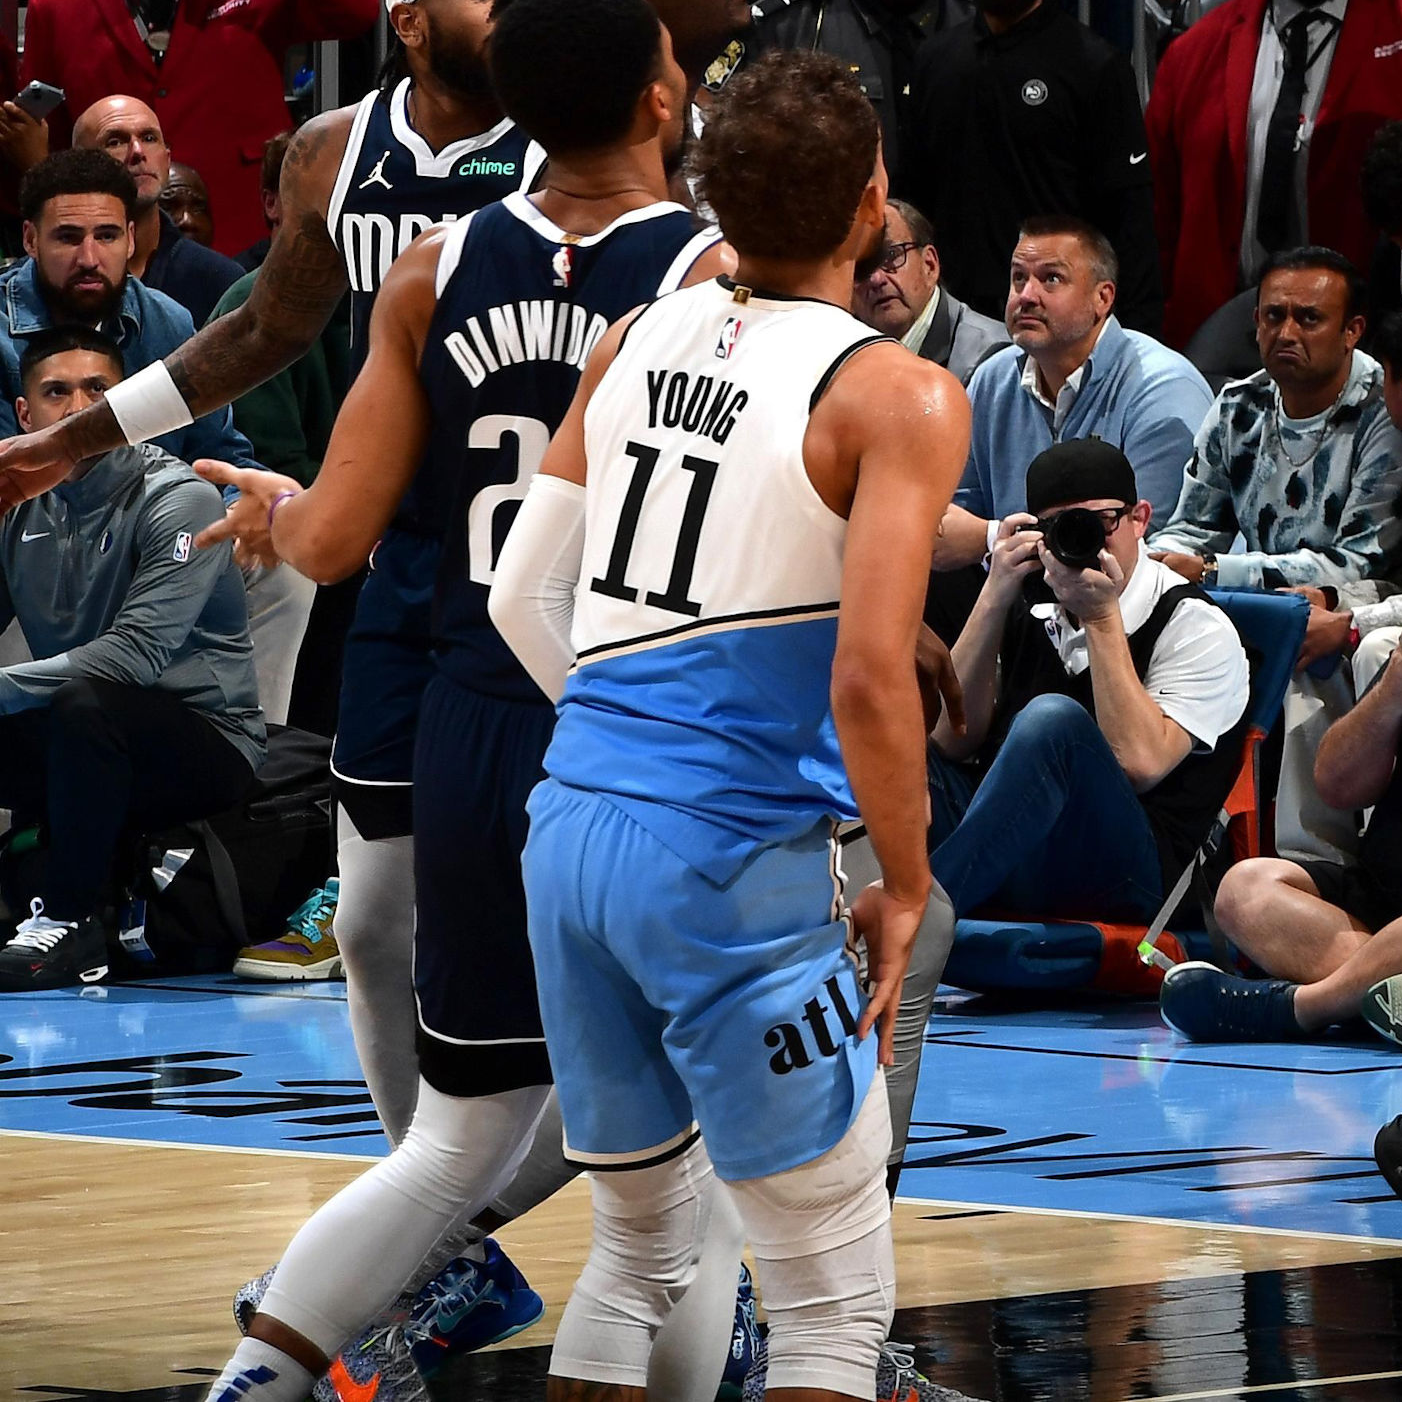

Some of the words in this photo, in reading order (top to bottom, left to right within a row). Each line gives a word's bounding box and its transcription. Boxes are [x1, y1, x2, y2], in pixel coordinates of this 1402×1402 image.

[458, 156, 516, 177] chime
[443, 299, 610, 388] DINWIDD
[647, 369, 749, 446] YOUNG
[590, 440, 720, 618] 11
[762, 975, 858, 1076] atl
